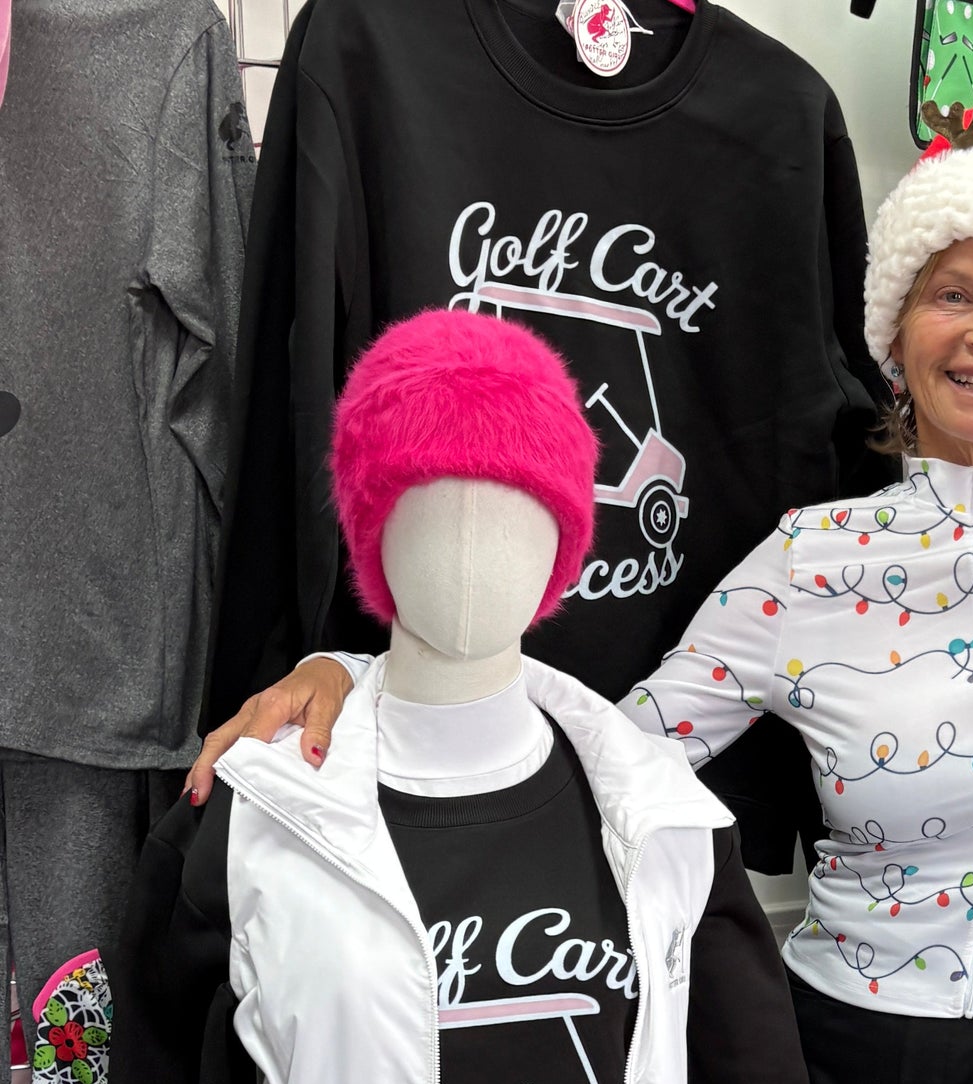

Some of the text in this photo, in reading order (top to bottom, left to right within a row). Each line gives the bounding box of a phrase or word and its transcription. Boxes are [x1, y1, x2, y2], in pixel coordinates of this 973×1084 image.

[449, 201, 719, 333] Golf Cart
[561, 551, 684, 600] cess
[428, 915, 482, 1010] lf
